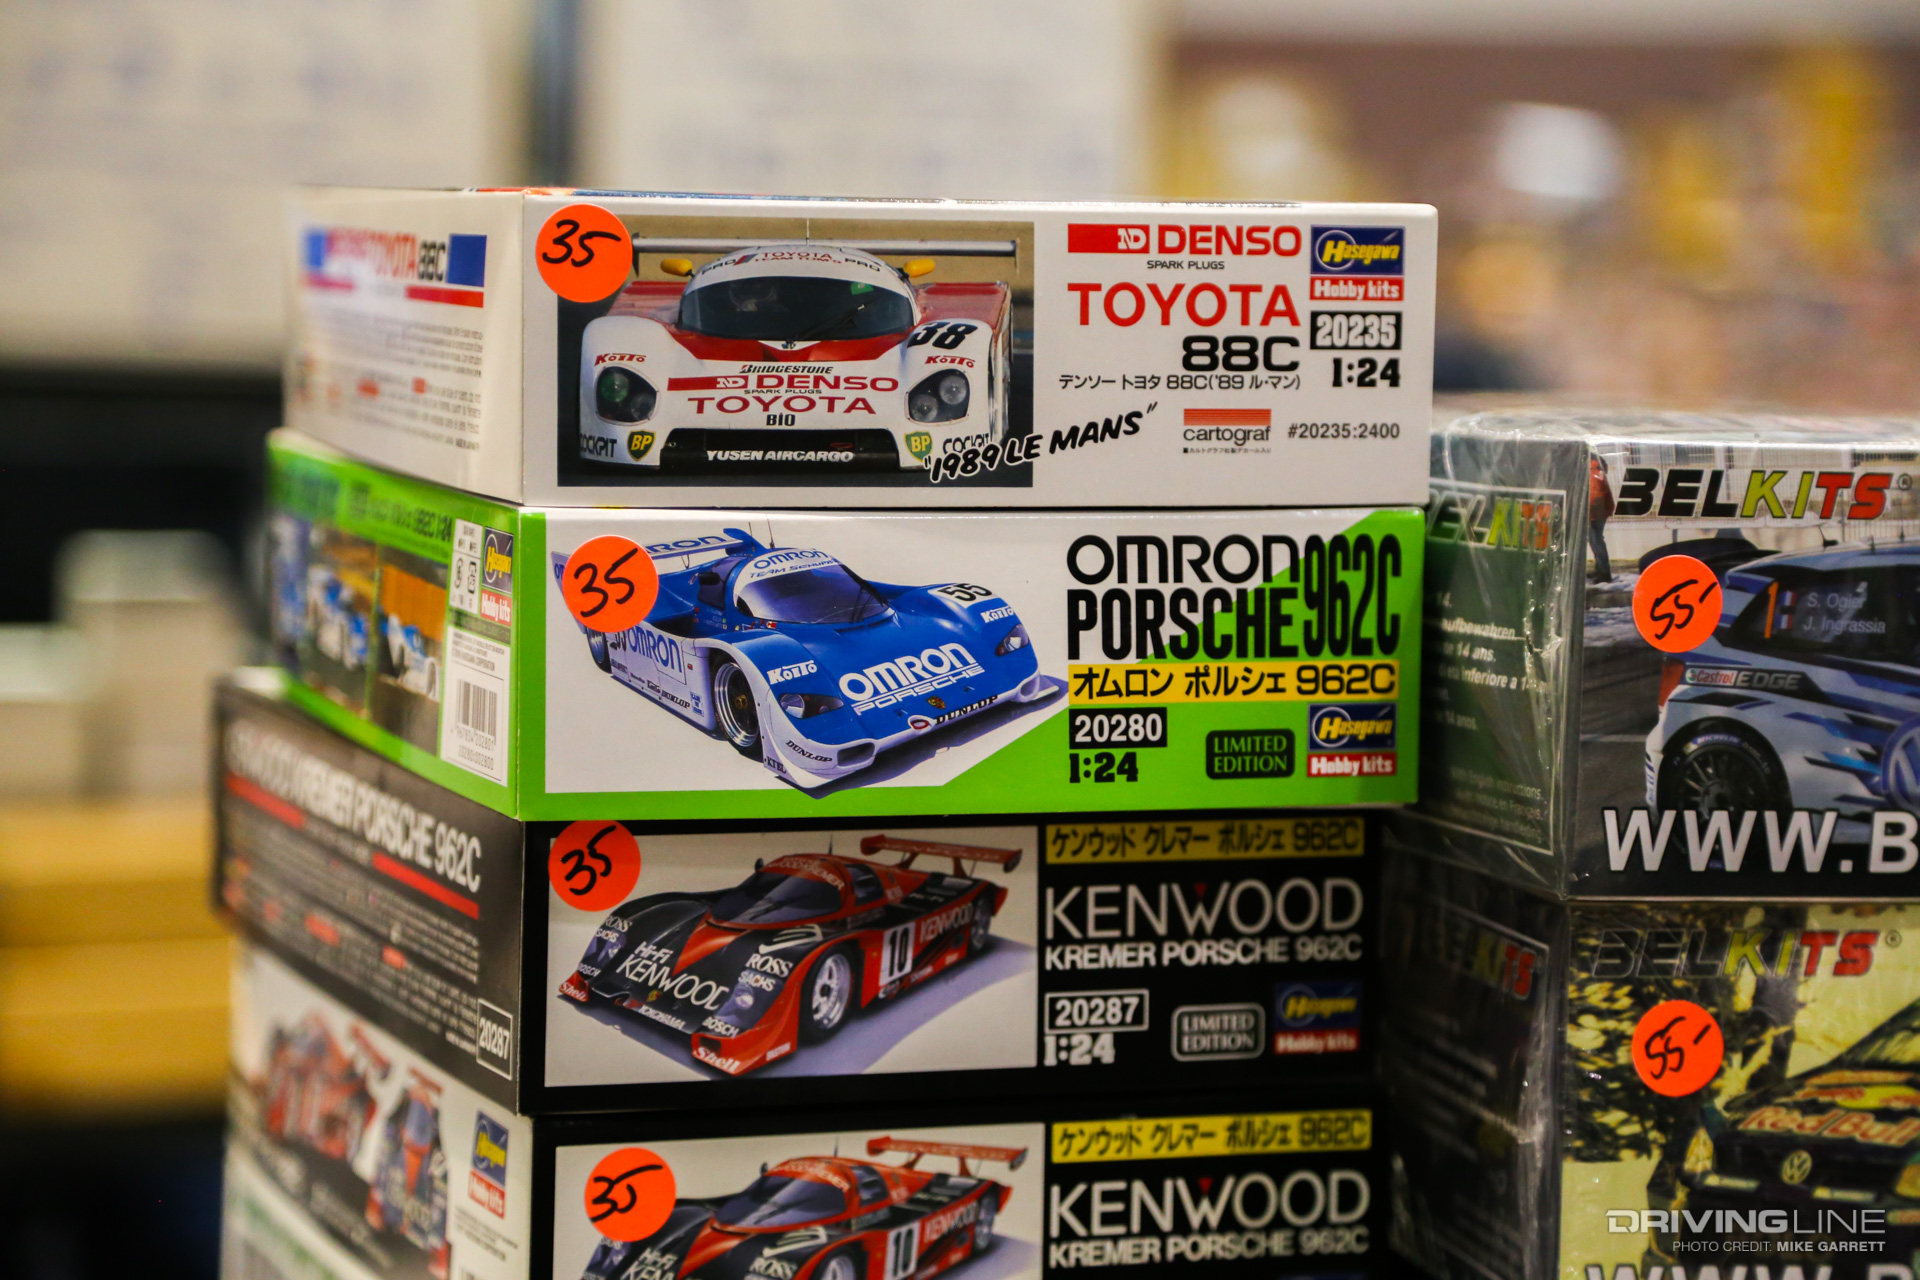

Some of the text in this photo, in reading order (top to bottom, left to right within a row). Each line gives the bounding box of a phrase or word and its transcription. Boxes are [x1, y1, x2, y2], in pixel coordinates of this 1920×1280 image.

[542, 219, 621, 268] 35
[1157, 225, 1303, 257] DENSO
[1322, 240, 1400, 265] Hasegawa
[763, 251, 833, 260] TOYOTA
[844, 257, 881, 272] PRO
[1146, 260, 1226, 270] SPARK PLUGS
[1314, 279, 1400, 301] Hobby kits
[1067, 282, 1301, 327] TOYOTA
[907, 322, 978, 350] 38
[1316, 314, 1397, 348] 20235
[1182, 334, 1301, 372] 88C
[739, 364, 834, 375] BRIDGESTONE
[756, 375, 899, 392] DENSO
[1059, 374, 1116, 390] デンソー
[1121, 374, 1162, 390] トヨタ
[1331, 358, 1400, 388] 1:24
[688, 395, 877, 415] TOYOTA
[630, 434, 653, 450] BP
[910, 435, 931, 452] BP
[1183, 426, 1271, 446] cartograf
[1288, 422, 1400, 440] #20235:2400
[707, 450, 763, 461] YUSEN
[1005, 433, 1043, 465] LE
[1614, 467, 1894, 520] BELKITS
[749, 567, 786, 578] TEAM
[753, 550, 829, 569] OMRON
[1067, 534, 1300, 585] OMRON
[573, 547, 639, 618] 35
[938, 583, 993, 602] 55
[1303, 533, 1402, 658] 962C
[1808, 592, 1865, 612] S. Ogier
[1067, 587, 1299, 660] PORSCHE
[1803, 616, 1887, 635] J. Ingrassia
[626, 625, 682, 673] OMRON
[838, 642, 977, 702] OMRON
[1073, 664, 1397, 699] オムロン ポルシェ 962C
[1696, 669, 1803, 690] Castrol EDGE
[661, 689, 691, 709] DUNLOP
[850, 664, 985, 716] PORSCHE
[934, 695, 1000, 726] DUNLOP
[1074, 713, 1164, 743] 20280
[1318, 717, 1394, 740] Hasegawa
[785, 739, 833, 763] DUNLOP
[1213, 735, 1288, 754] LIMITED
[1069, 752, 1139, 784] 1:24
[1213, 755, 1288, 774] EDITION
[1310, 757, 1393, 776] Hobby kits
[354, 778, 435, 870] PORSCHE
[434, 820, 482, 894] 962C
[1144, 825, 1211, 856] クレマー
[1292, 818, 1361, 851] 962C
[560, 825, 617, 896] 35
[1045, 877, 1364, 940] KENWOOD
[634, 941, 673, 964] Hi-Fi
[745, 953, 794, 978] ROSS
[888, 927, 910, 978] 10
[1045, 934, 1363, 971] KREMER PORSCHE 962C
[1592, 927, 1880, 979] BELKITS
[559, 981, 587, 1002] Shell
[737, 971, 777, 992] SACHS
[1054, 997, 1141, 1028] 20287
[1182, 1013, 1256, 1033] LIMITED
[479, 1016, 510, 1060] 20287
[701, 1015, 741, 1040] BOSCH
[1043, 1033, 1116, 1067] 1:24
[1182, 1033, 1256, 1053] EDITION
[693, 1045, 741, 1074] Shell
[1298, 1115, 1368, 1147] 962C
[1050, 1169, 1371, 1238] KENWOOD
[1050, 1225, 1370, 1269] KREMER PORSCHE 962C
